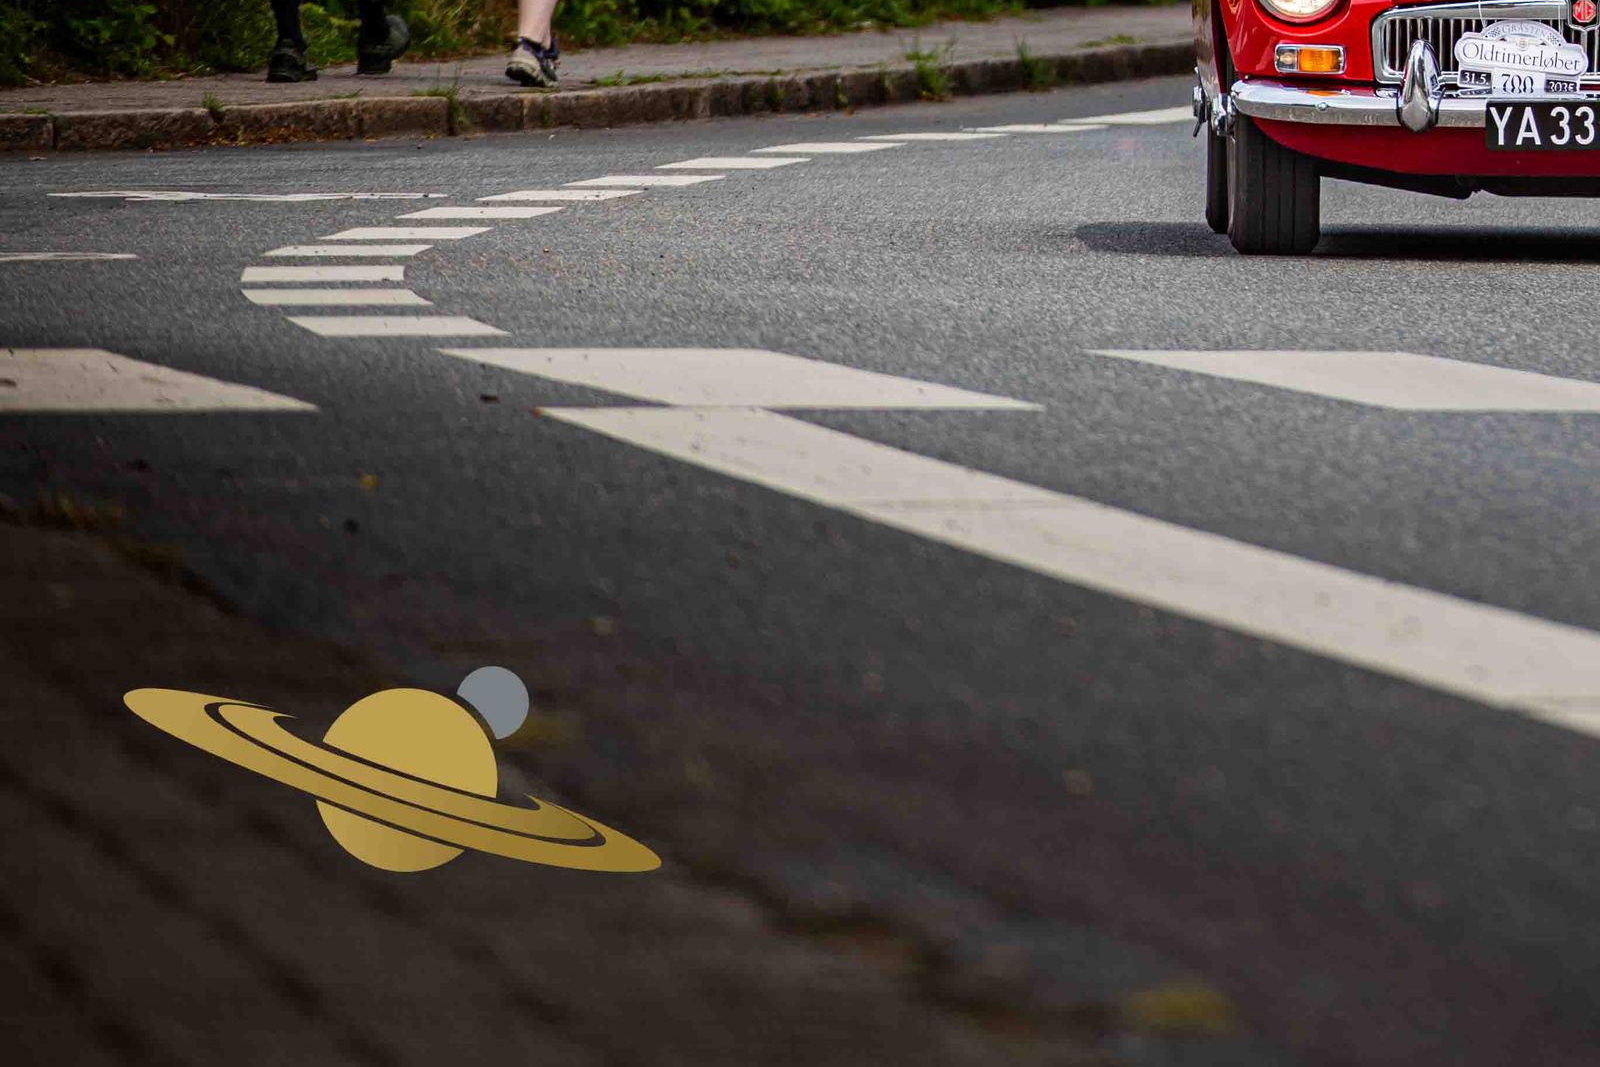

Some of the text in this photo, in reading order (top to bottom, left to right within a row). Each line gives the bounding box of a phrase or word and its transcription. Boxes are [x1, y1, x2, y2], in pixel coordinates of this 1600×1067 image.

[1574, 0, 1596, 22] MG
[1462, 42, 1580, 71] Oldtimerløbet
[1463, 72, 1489, 85] 31.5.
[1489, 106, 1542, 146] YA
